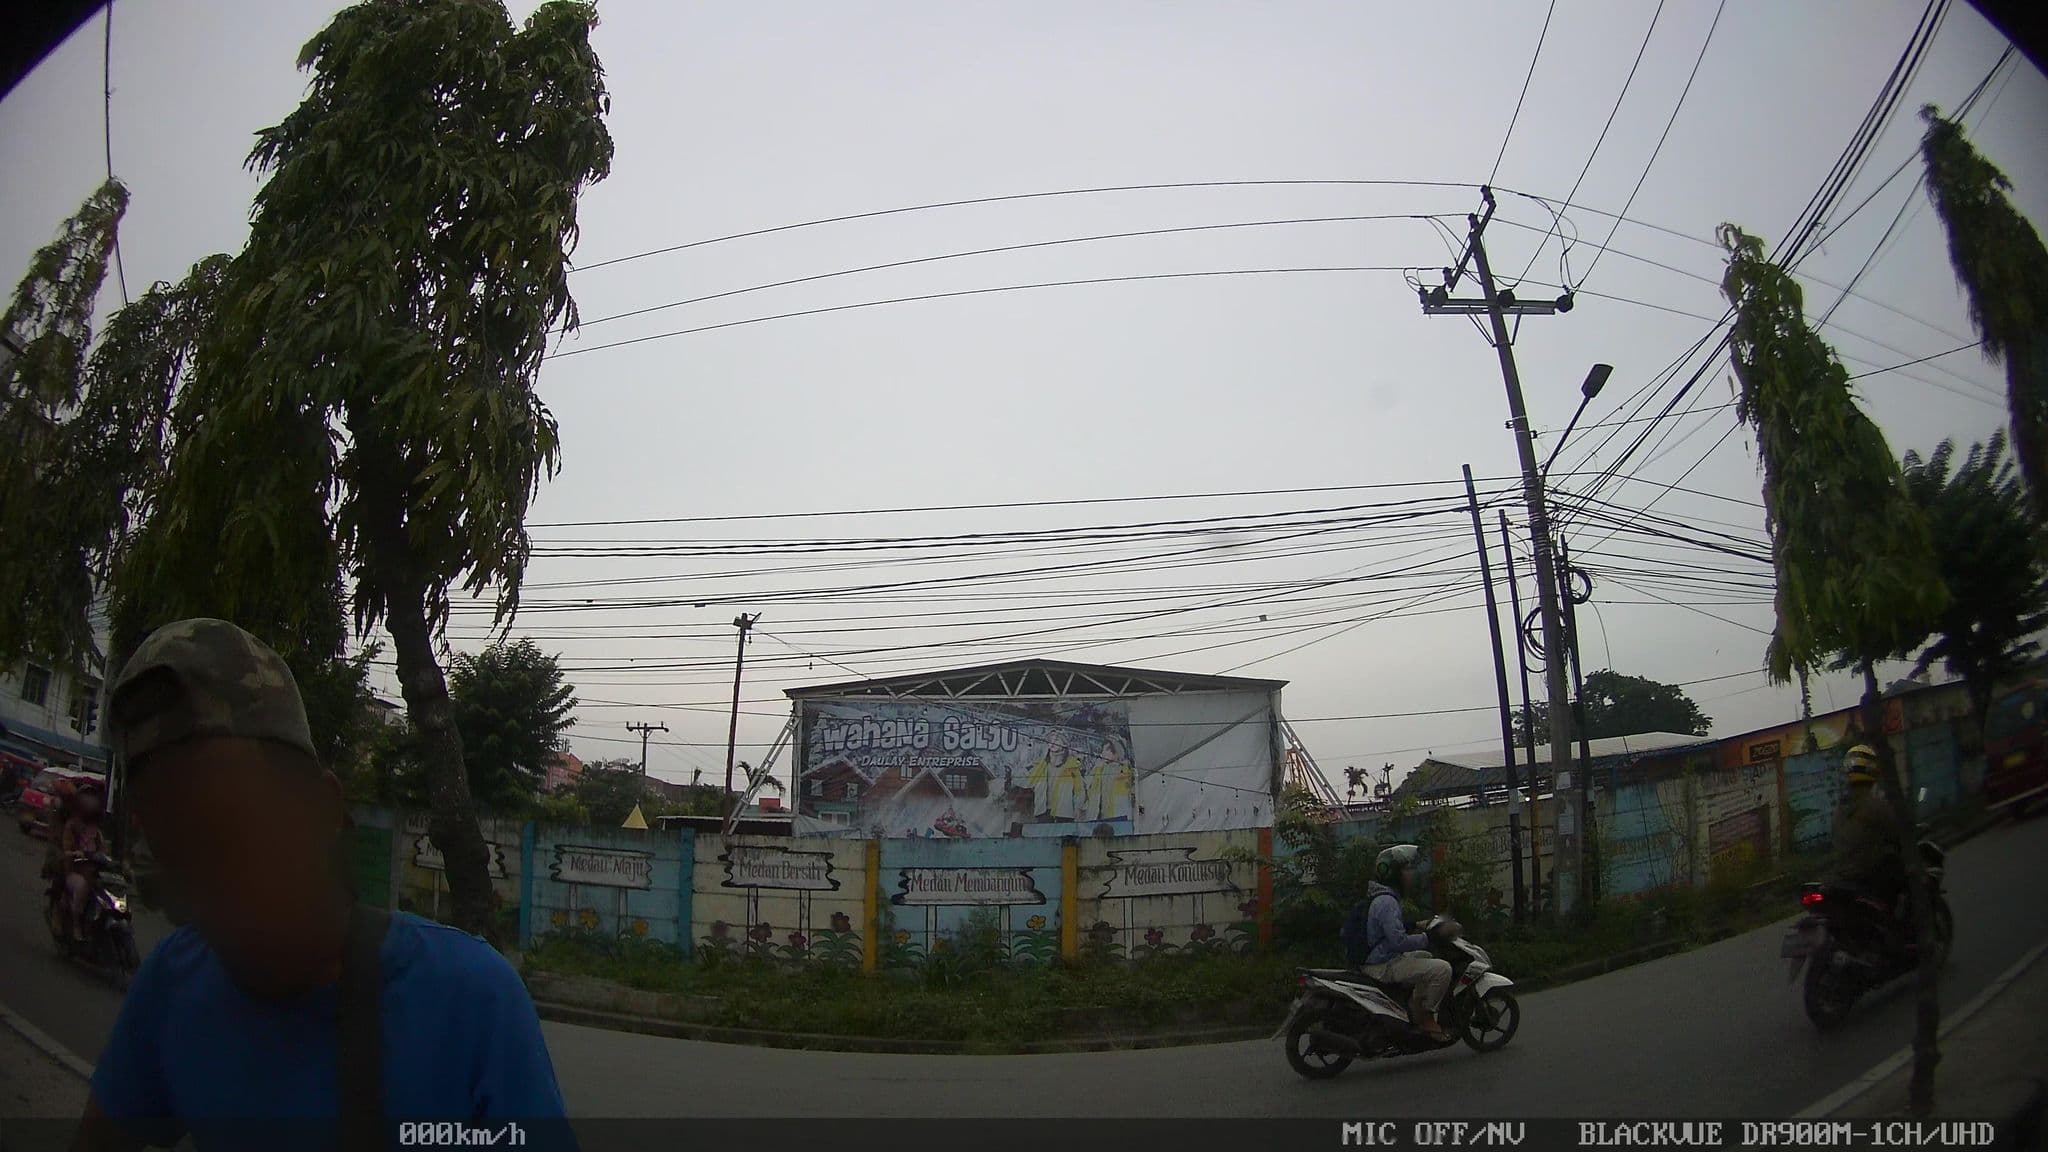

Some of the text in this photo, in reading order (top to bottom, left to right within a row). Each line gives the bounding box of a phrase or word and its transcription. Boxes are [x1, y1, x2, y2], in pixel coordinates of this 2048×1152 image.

[861, 755, 980, 767] DAULAY ENTREPRISE
[570, 855, 644, 881] Medan Maju
[739, 859, 821, 880] Medan Bersih
[1124, 863, 1166, 886] Medan
[911, 873, 1026, 896] Medan Membangun
